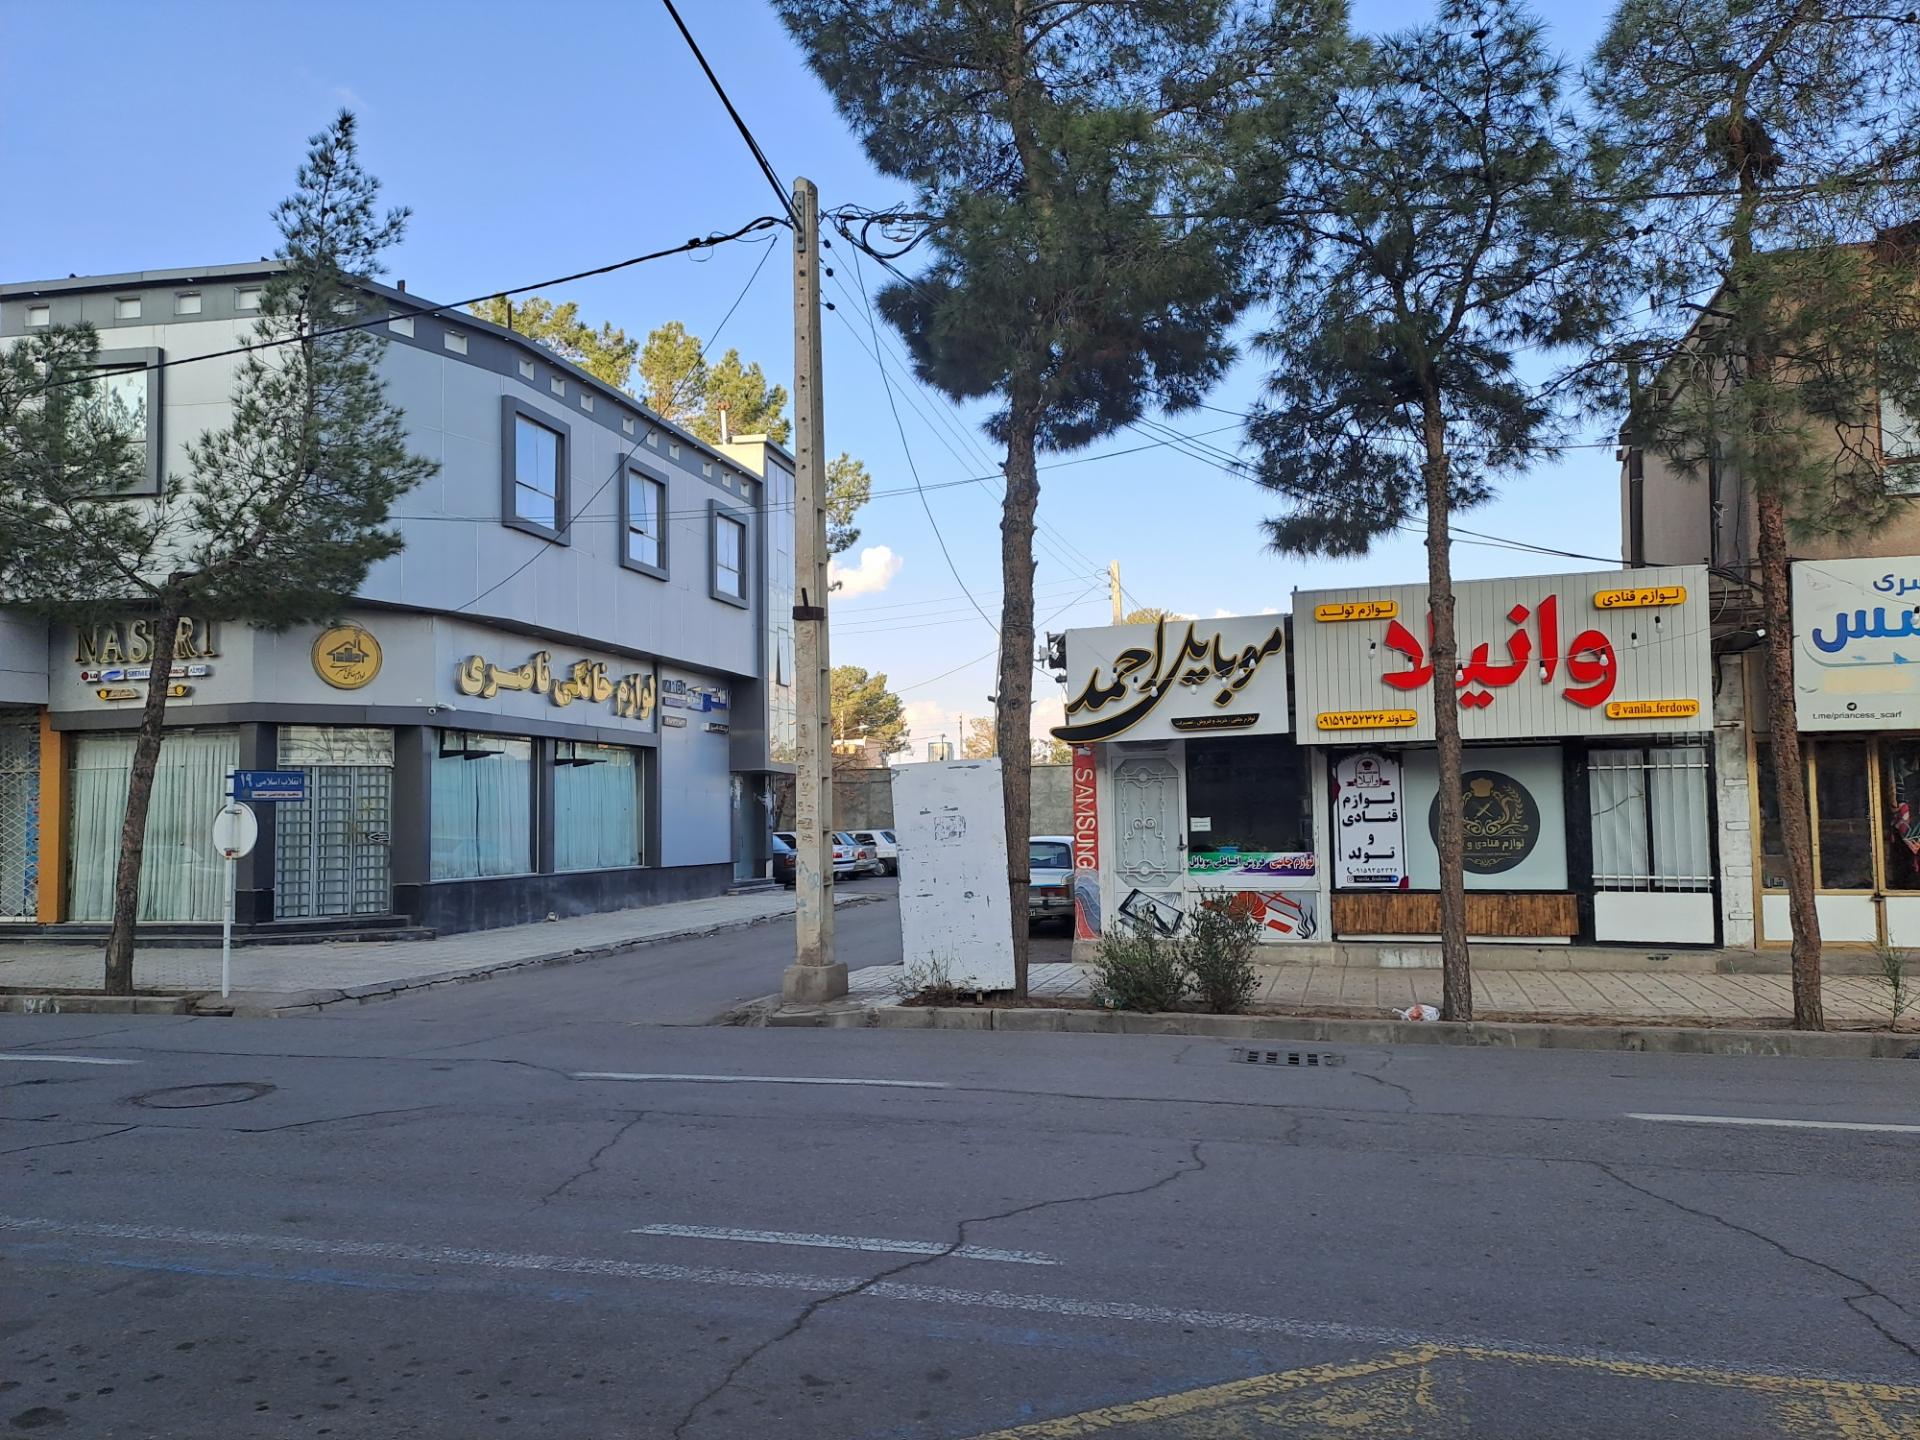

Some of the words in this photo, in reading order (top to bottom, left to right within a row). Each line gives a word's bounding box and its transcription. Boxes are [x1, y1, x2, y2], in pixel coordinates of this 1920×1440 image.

[1602, 590, 1636, 607] قنادی
[1640, 589, 1679, 604] لوازم
[1320, 605, 1354, 618] تولد
[1358, 603, 1394, 617] لوازم
[75, 616, 215, 664] NASRI
[1066, 614, 1164, 714] احمد
[460, 651, 550, 698] ناصری
[553, 658, 613, 707] خانگی
[1049, 622, 1283, 743] موبایل
[616, 672, 656, 720] لوازم
[240, 773, 253, 789] ۱۹
[255, 777, 280, 788] اسلامی
[281, 776, 302, 786] انقلاب
[1342, 792, 1395, 809] لوازم
[1074, 767, 1097, 871] SAMSUNG
[1342, 808, 1398, 827] قنادی
[1367, 833, 1375, 845] و
[1502, 838, 1525, 851] لوازم
[1243, 856, 1265, 869] فروش
[1294, 853, 1314, 870] لوازم
[1348, 846, 1395, 864] تولد
